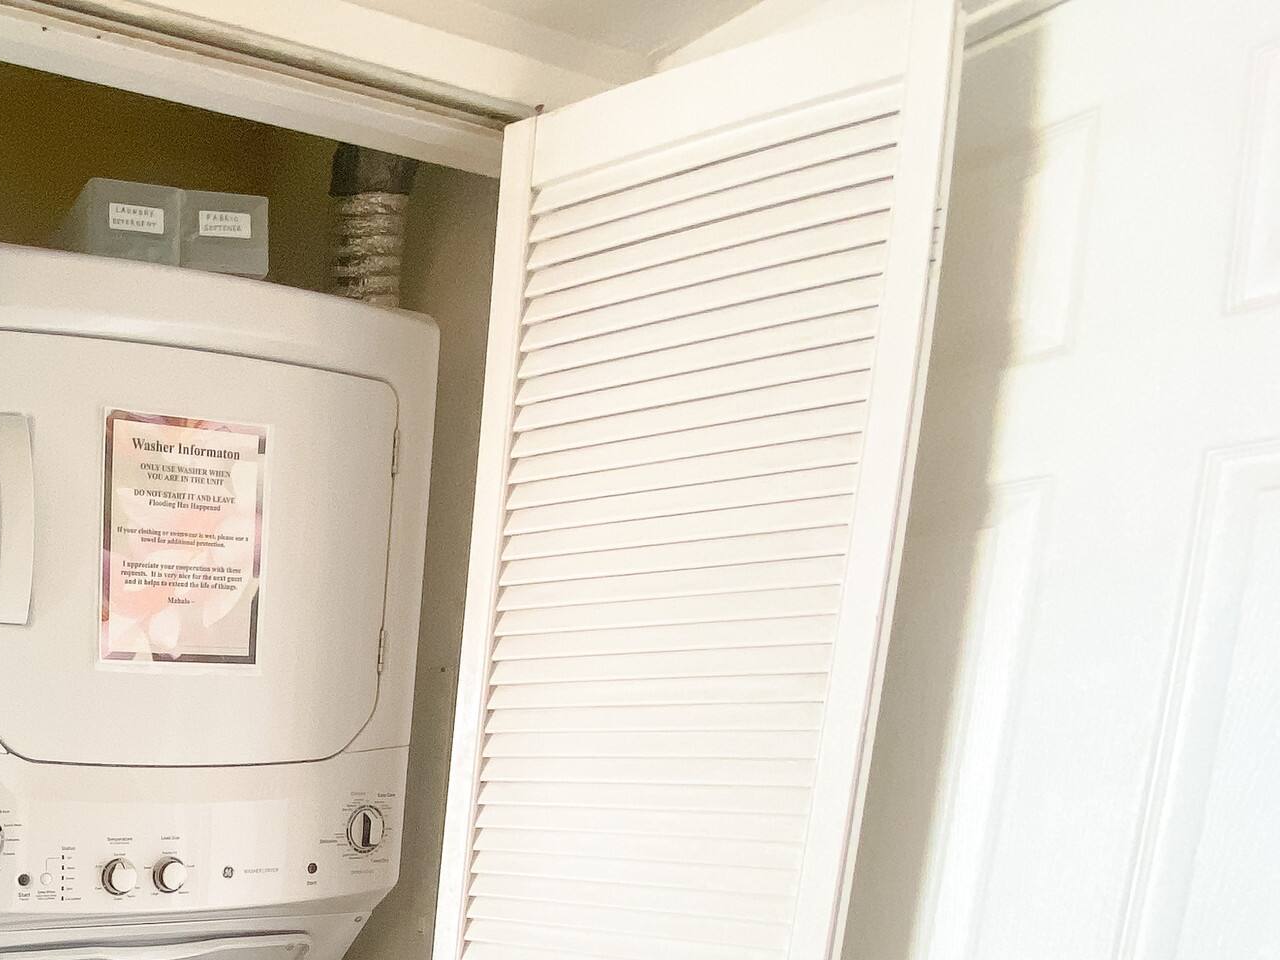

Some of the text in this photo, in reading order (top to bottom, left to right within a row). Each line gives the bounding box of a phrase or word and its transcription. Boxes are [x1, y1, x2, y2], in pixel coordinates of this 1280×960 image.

[132, 437, 175, 453] Washer
[140, 463, 231, 478] ONLY USE WASHER WHEN
[147, 472, 224, 486] YOU ARE IN THE UNIT
[146, 490, 161, 498] NOT
[163, 491, 186, 500] START
[197, 494, 211, 502] AND
[213, 495, 235, 504] LEAVE
[149, 499, 176, 509] Flooding
[190, 502, 221, 512] Happened
